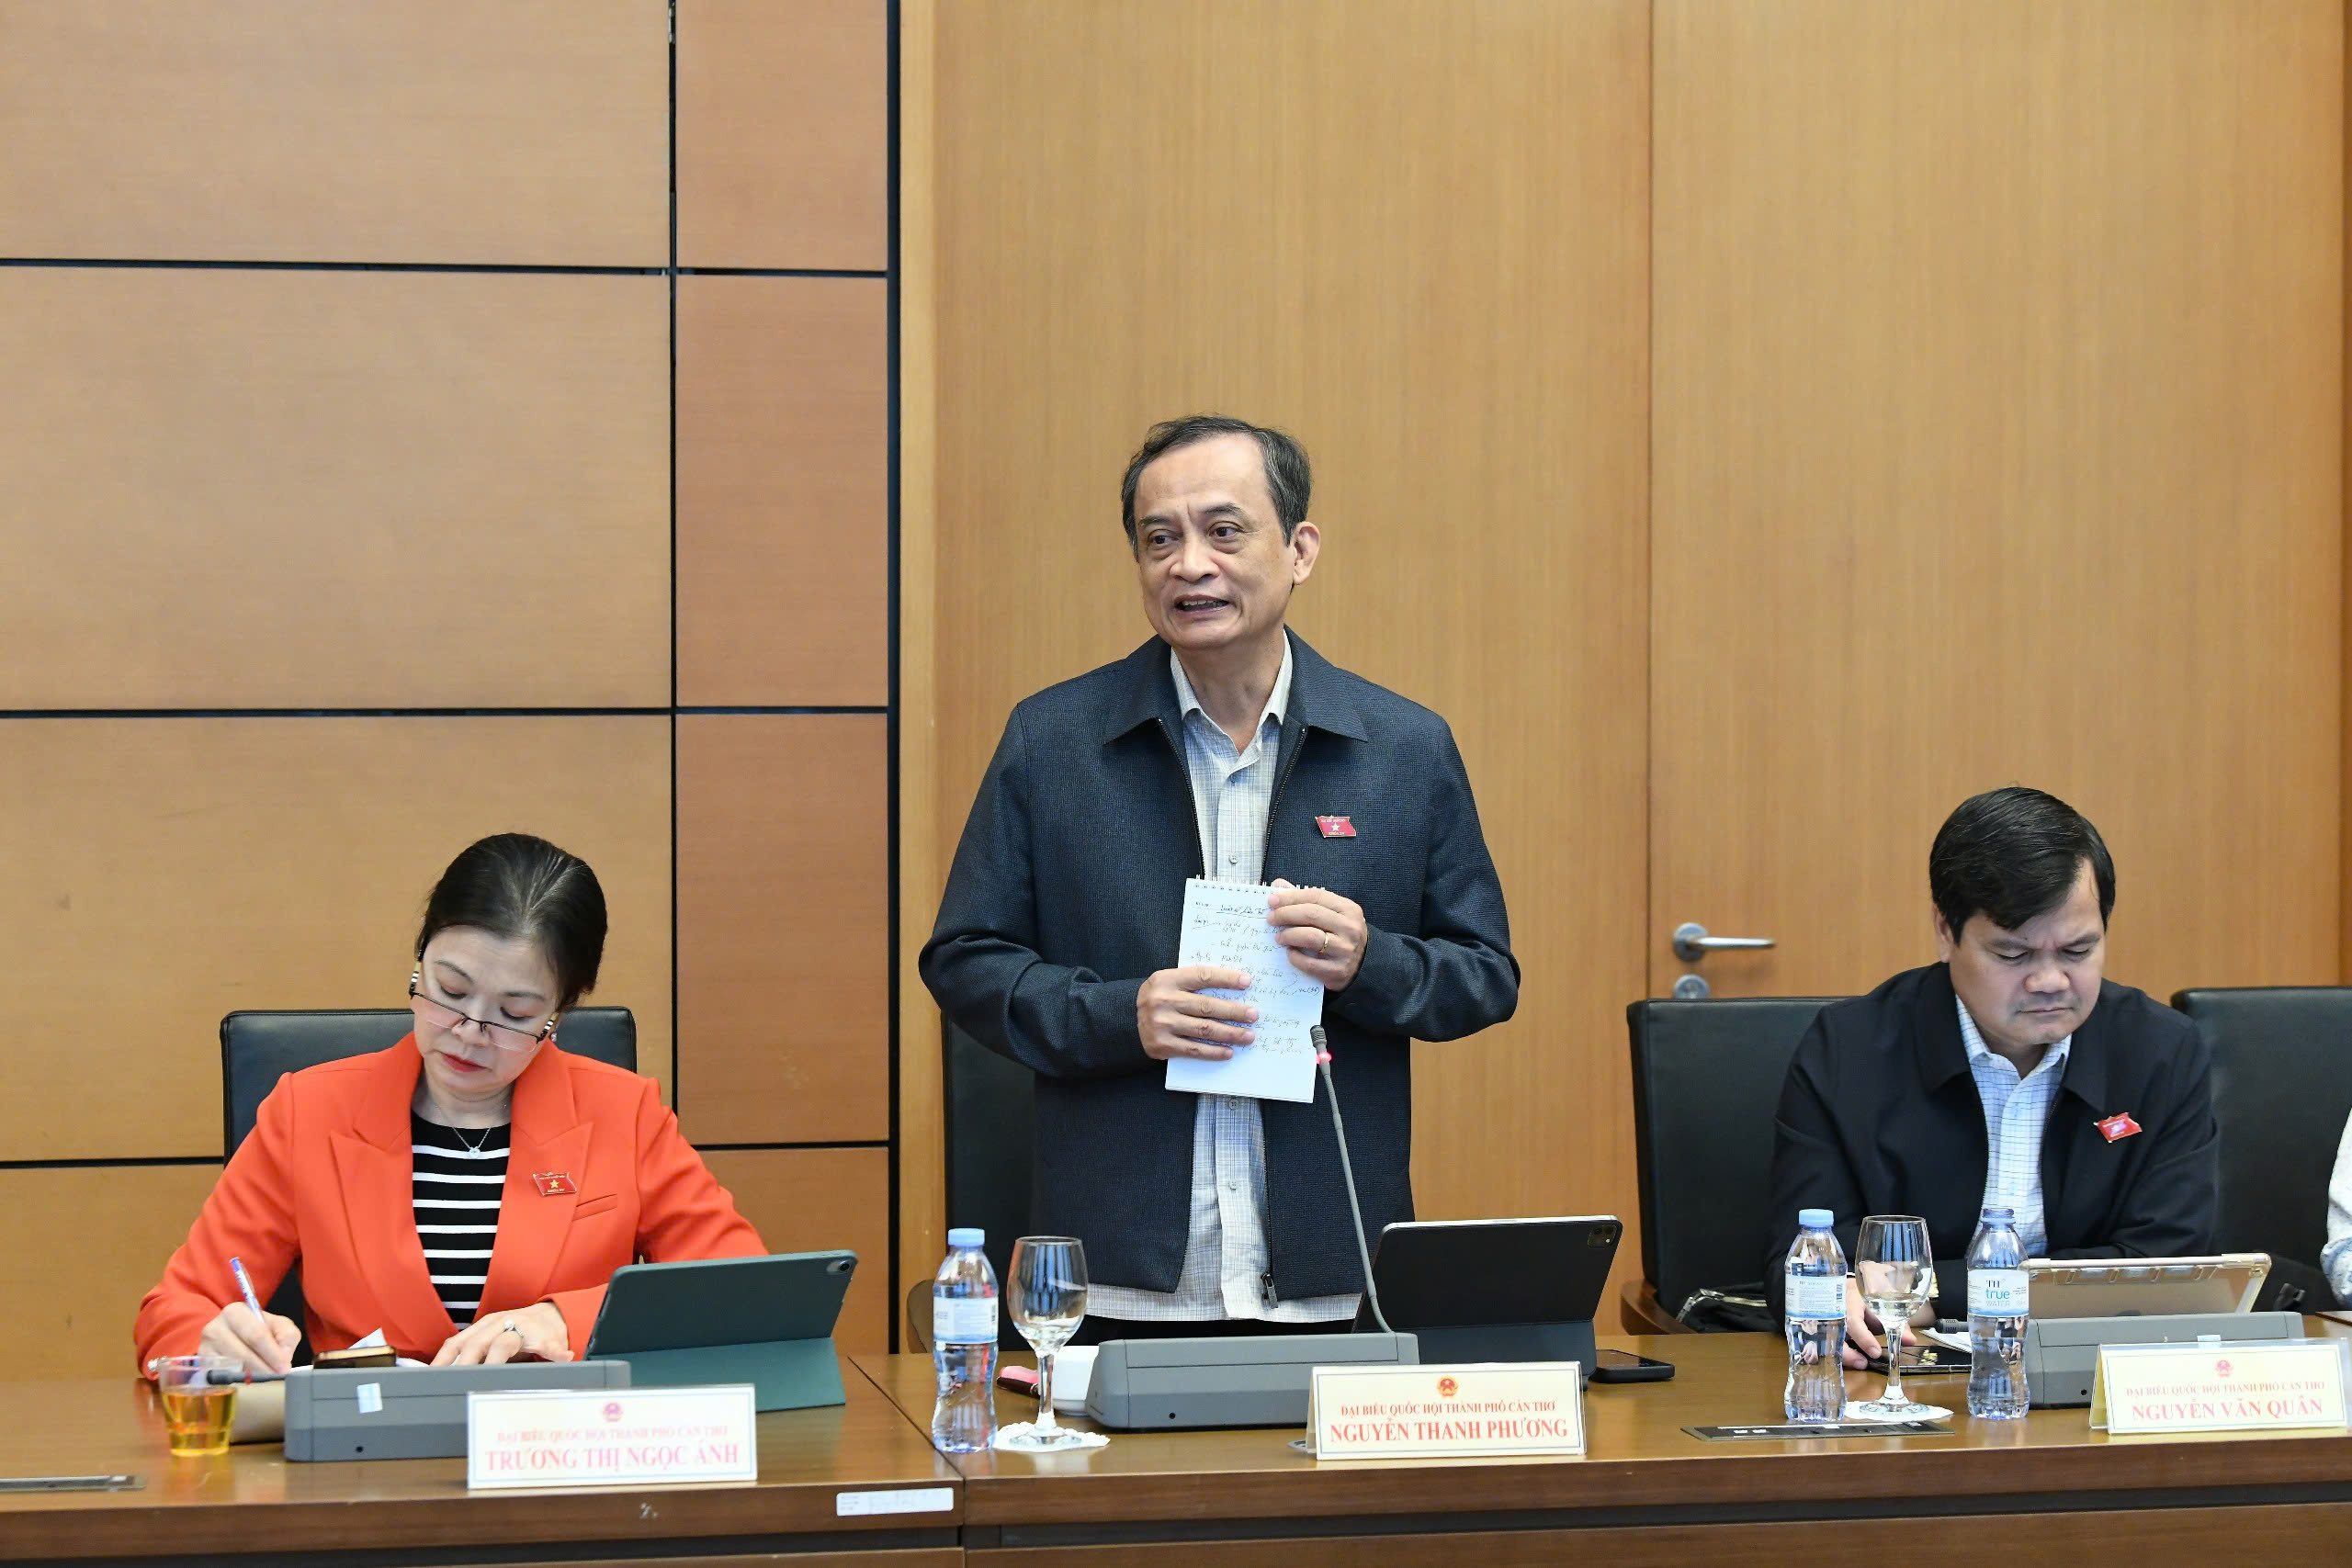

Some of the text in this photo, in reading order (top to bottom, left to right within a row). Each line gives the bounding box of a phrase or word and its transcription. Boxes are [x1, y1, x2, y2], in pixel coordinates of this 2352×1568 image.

[1985, 1287, 2010, 1300] true
[2125, 1387, 2143, 1398] ĐẠI
[1340, 1399, 1556, 1418] ĐẠI BIỂU QUỐC HỘI THÀNH PHỐ CẦN THƠ
[2132, 1394, 2324, 1420] NGUYỄN VĂN QUÂN
[1329, 1416, 1568, 1443] NGUYỄN THANH PHƯƠNG
[486, 1446, 578, 1472] TRƯƠNG
[582, 1446, 619, 1472] THỊ
[625, 1445, 687, 1471] NGỌC
